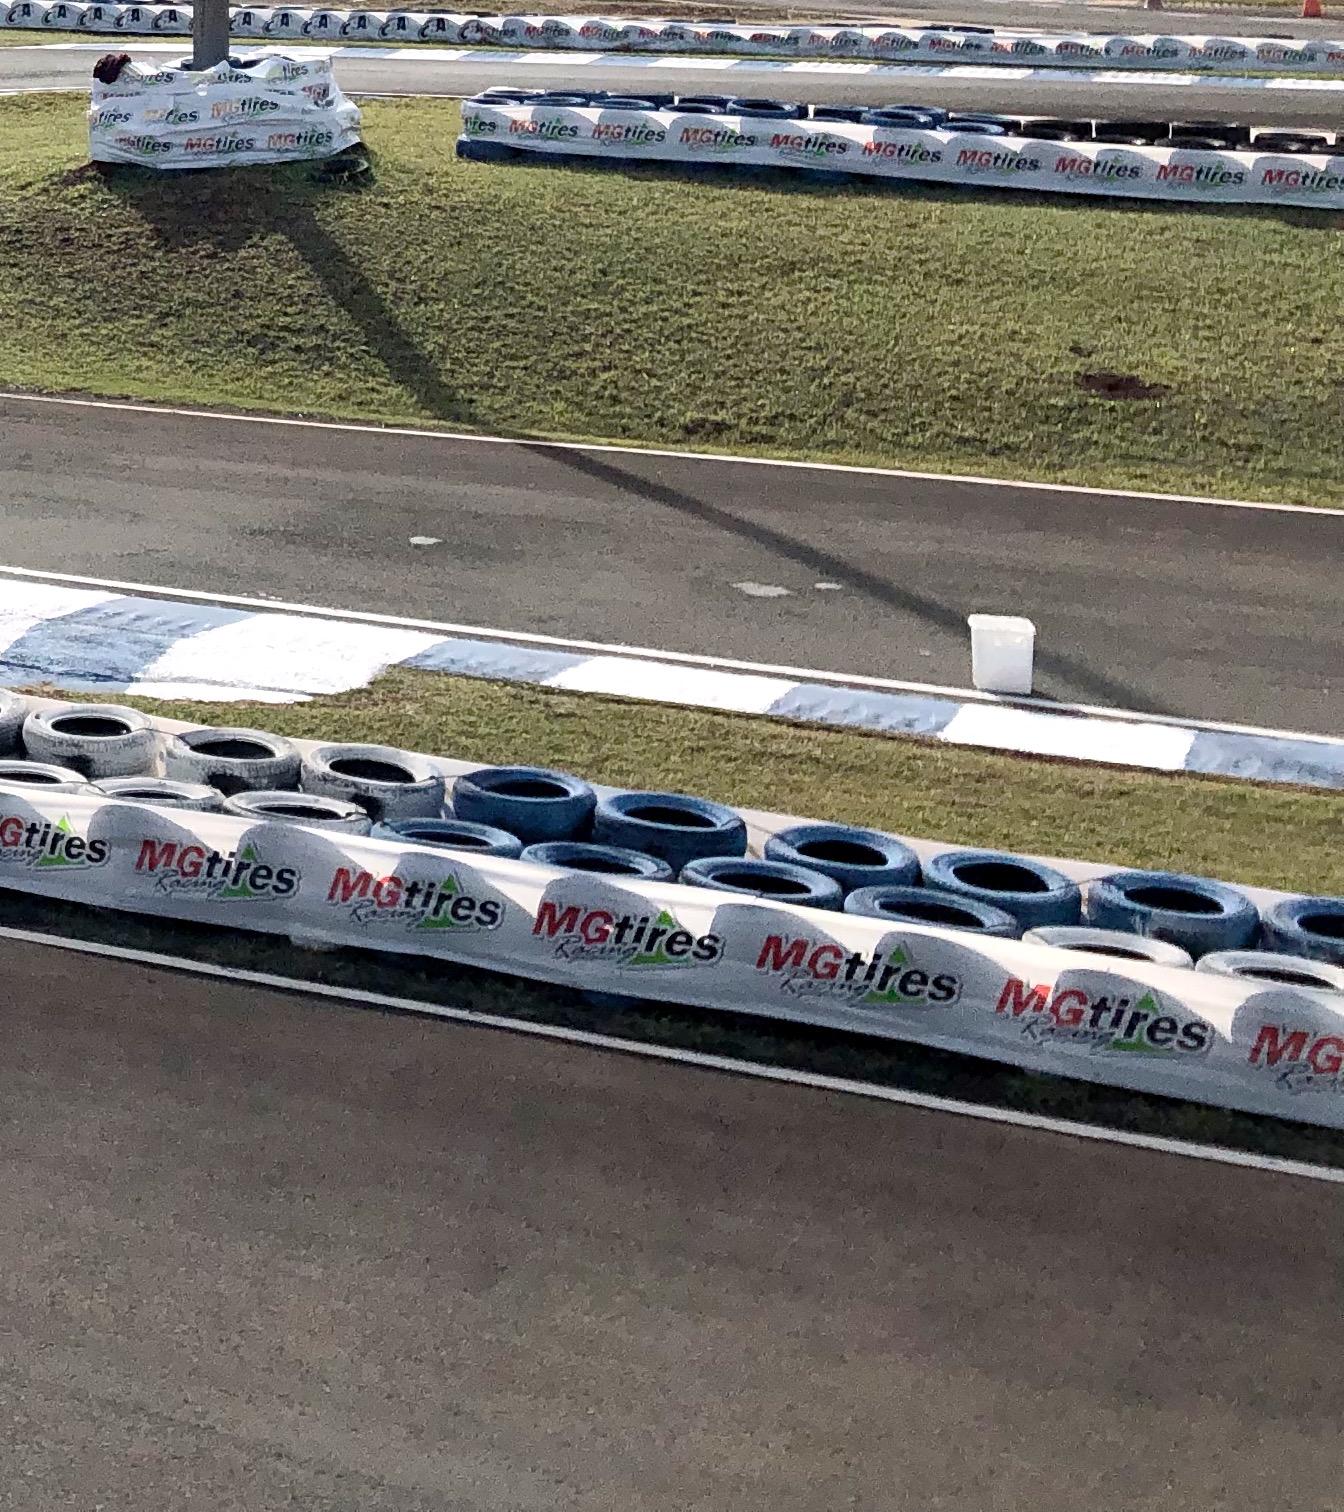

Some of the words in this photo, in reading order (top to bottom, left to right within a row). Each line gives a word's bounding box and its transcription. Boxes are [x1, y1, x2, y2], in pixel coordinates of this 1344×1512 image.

[212, 96, 279, 118] MGtires
[510, 119, 579, 138] MGtires
[593, 123, 666, 143] MGtires
[680, 127, 755, 148] MGtires
[184, 135, 254, 152] MGtires
[268, 131, 333, 148] MGtires
[771, 133, 847, 156] MGtires
[863, 141, 942, 164] MGtires
[957, 150, 1041, 173] MGtires
[1055, 156, 1141, 180] MGtires
[1156, 163, 1245, 187] MGtires
[135, 839, 297, 894] MGtires
[328, 868, 502, 928] MGtires
[533, 902, 722, 961] MGtires
[756, 935, 959, 1002] MGtires
[996, 978, 1209, 1052] MGtires
